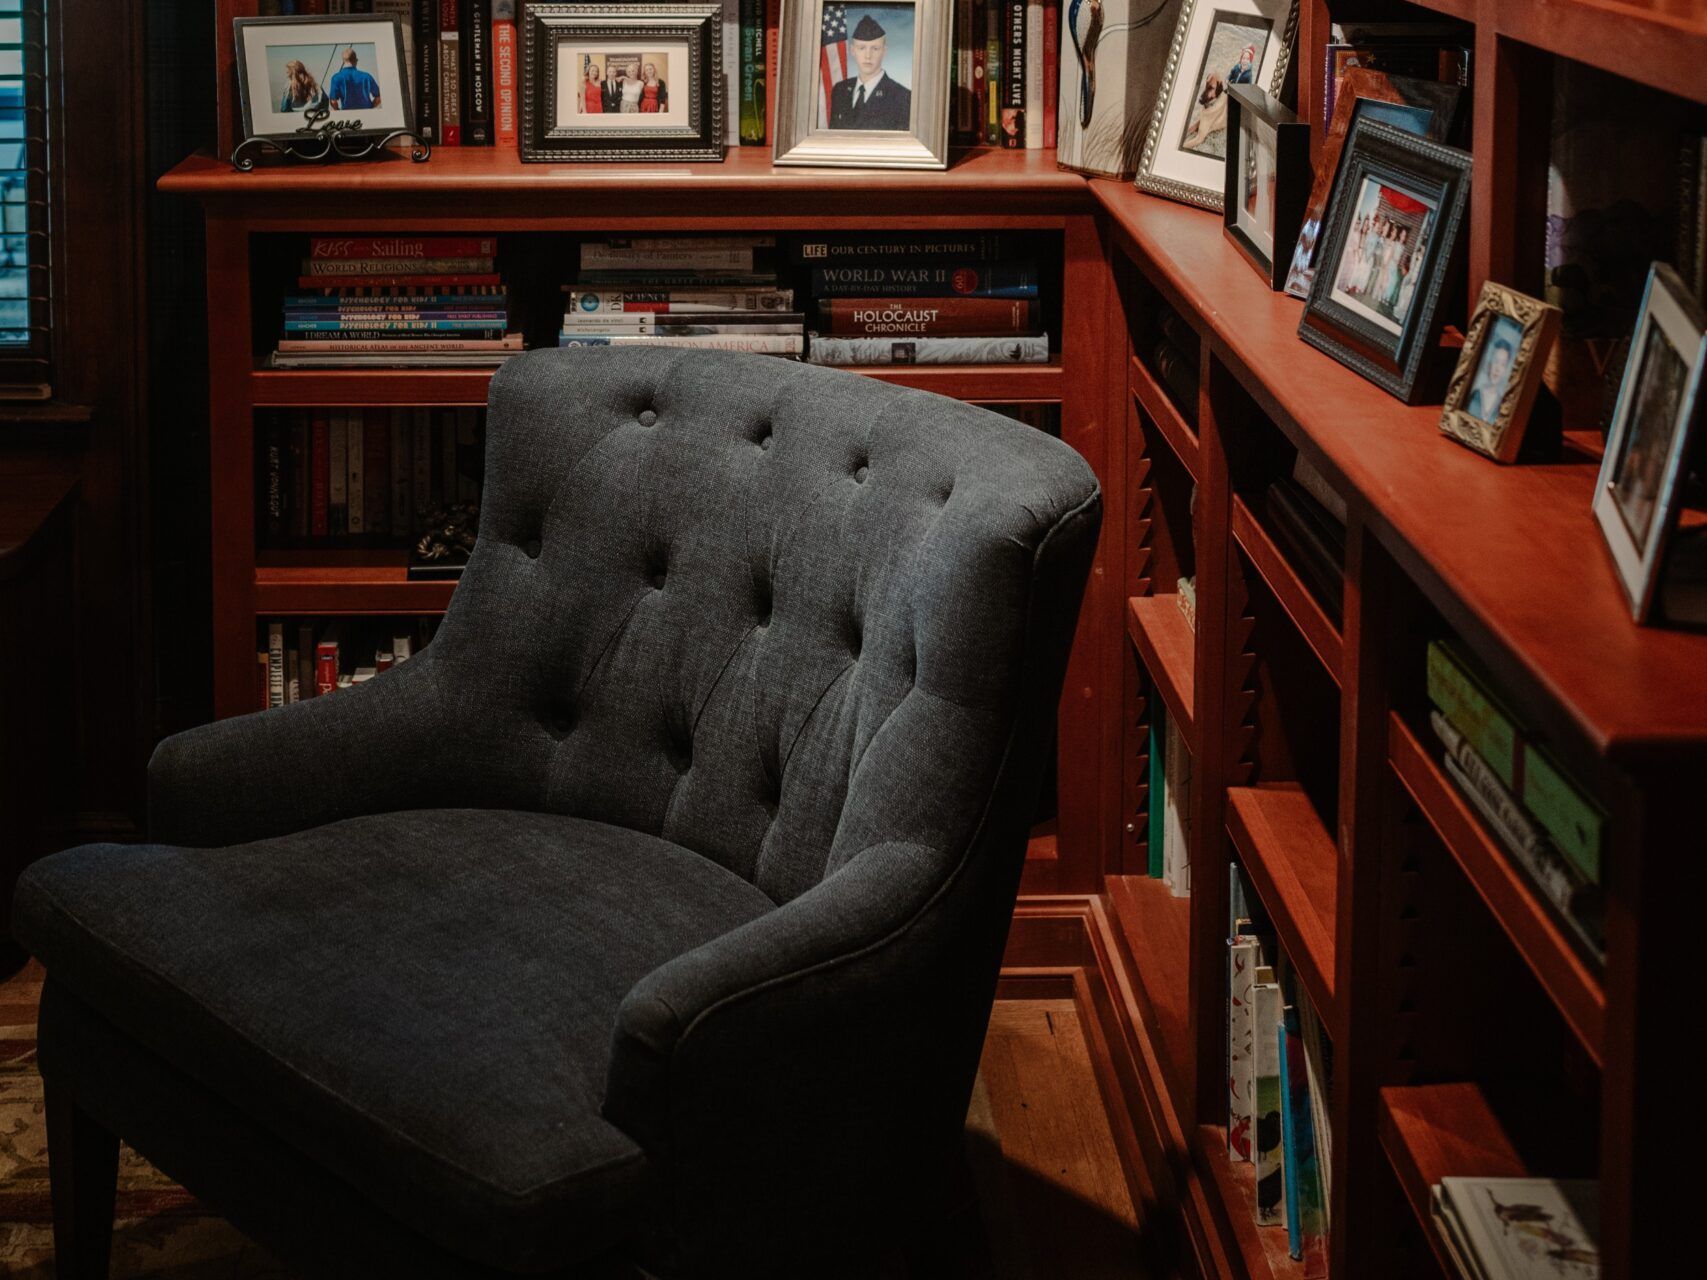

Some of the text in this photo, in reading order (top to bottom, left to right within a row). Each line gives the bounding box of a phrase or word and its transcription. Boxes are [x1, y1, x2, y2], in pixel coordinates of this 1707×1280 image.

[1012, 4, 1022, 44] OTHERS
[473, 12, 481, 60] GENTLEMAN
[474, 62, 482, 72] IN
[744, 27, 754, 101] Swan Green
[1011, 48, 1021, 80] MIGHT
[450, 78, 457, 89] SO
[499, 24, 513, 131] THE SECOND OPINION
[473, 74, 482, 113] MOSCOW
[1011, 82, 1021, 105] LIVE
[296, 108, 363, 134] Love
[371, 239, 424, 258] Sailing
[804, 243, 975, 257] LIFE OUR CENTURY IN PICTURES
[313, 261, 417, 274] WORLD RELIGIONS
[823, 269, 946, 282] WORLD WAR II
[624, 292, 669, 301] SCIENCE
[882, 285, 918, 293] HISTORY
[853, 310, 938, 322] HOLOCAUST
[308, 331, 338, 339] DREAM
[865, 323, 926, 332] CHRONICLE
[709, 340, 768, 352] AMERICA
[269, 447, 279, 517] KURT VONNEGUT
[270, 647, 283, 688] COMPLETE
